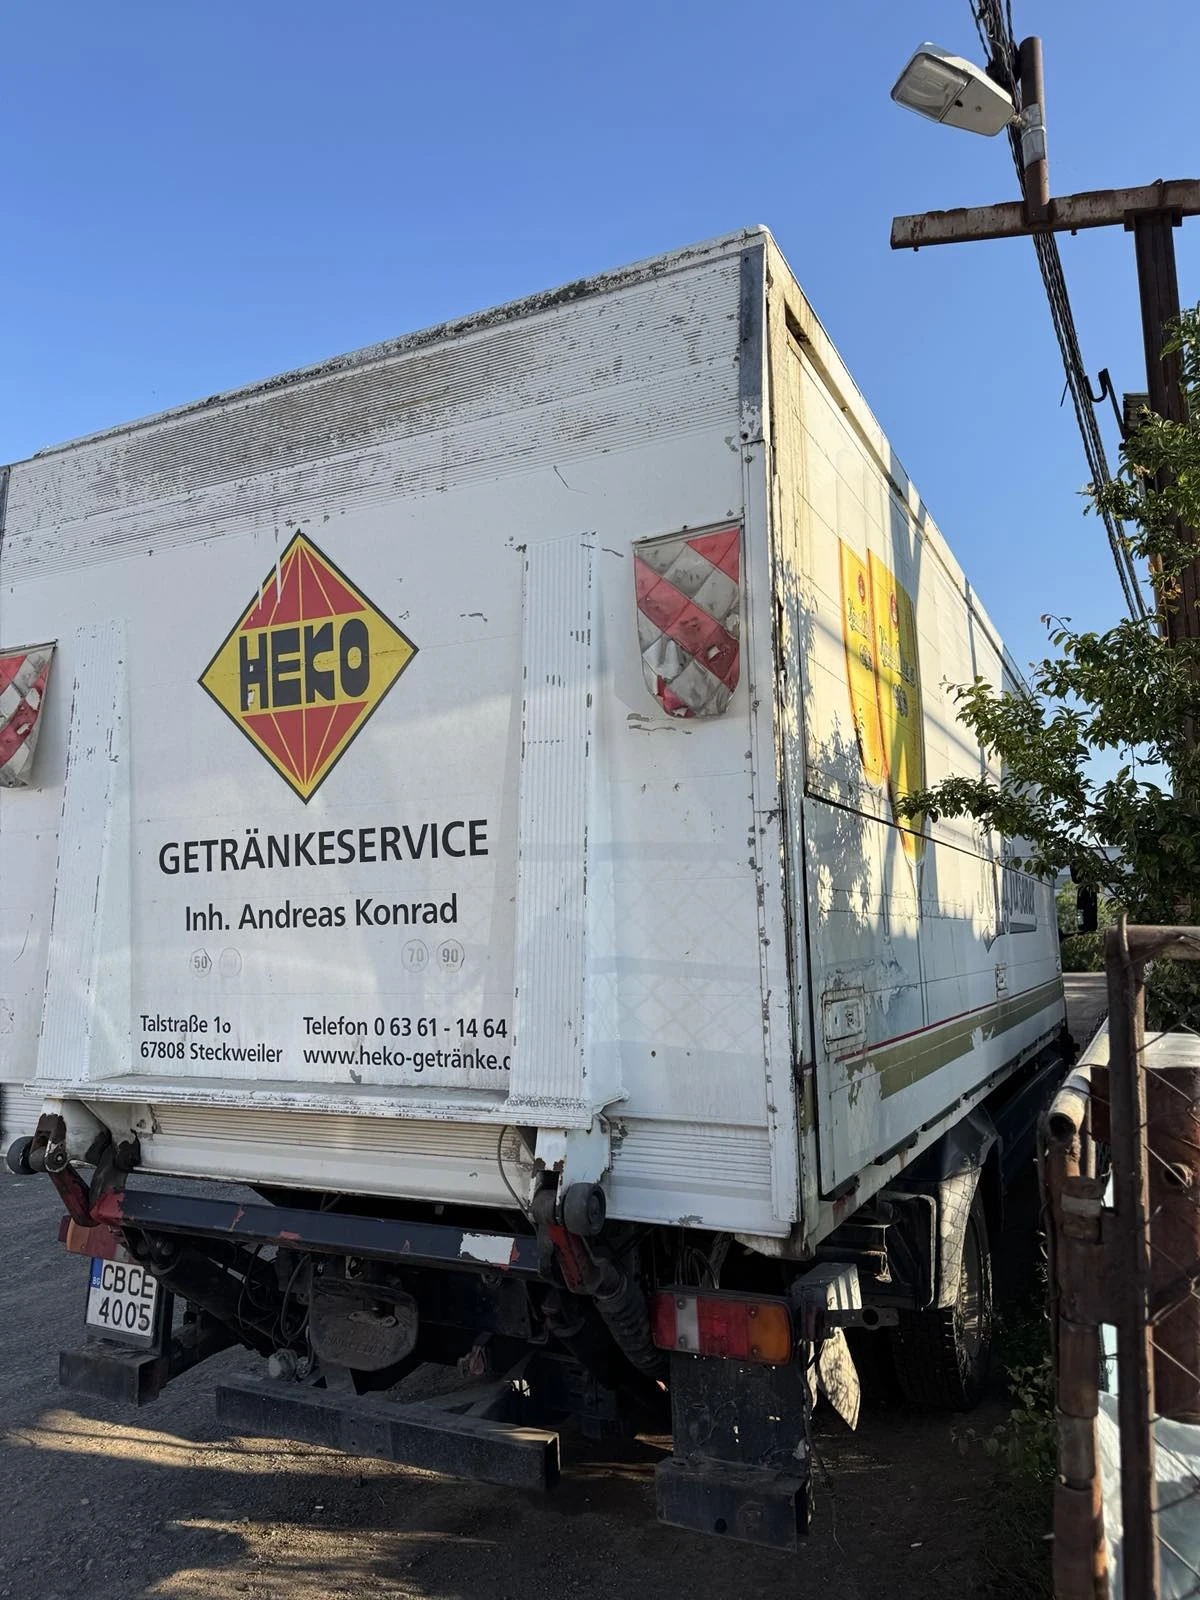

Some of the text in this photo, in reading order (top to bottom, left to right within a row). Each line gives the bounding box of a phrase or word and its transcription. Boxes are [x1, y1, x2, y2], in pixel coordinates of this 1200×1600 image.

[239, 618, 370, 712] HEKO
[159, 819, 489, 875] GETRÄNKESERVICE
[186, 893, 457, 931] Inh. Andreas Konrad
[194, 955, 208, 969] 50
[407, 948, 424, 962] 70
[442, 948, 458, 963] 90
[140, 1014, 208, 1033] Talstraße
[303, 1016, 368, 1036] Telefon
[374, 1017, 385, 1036] 0
[390, 1017, 412, 1037] 63
[417, 1018, 437, 1037] 61
[456, 1018, 478, 1038] 14
[483, 1018, 508, 1038] 64
[140, 1041, 283, 1063] 67808 Steckweiler
[98, 1296, 150, 1331] 4005
